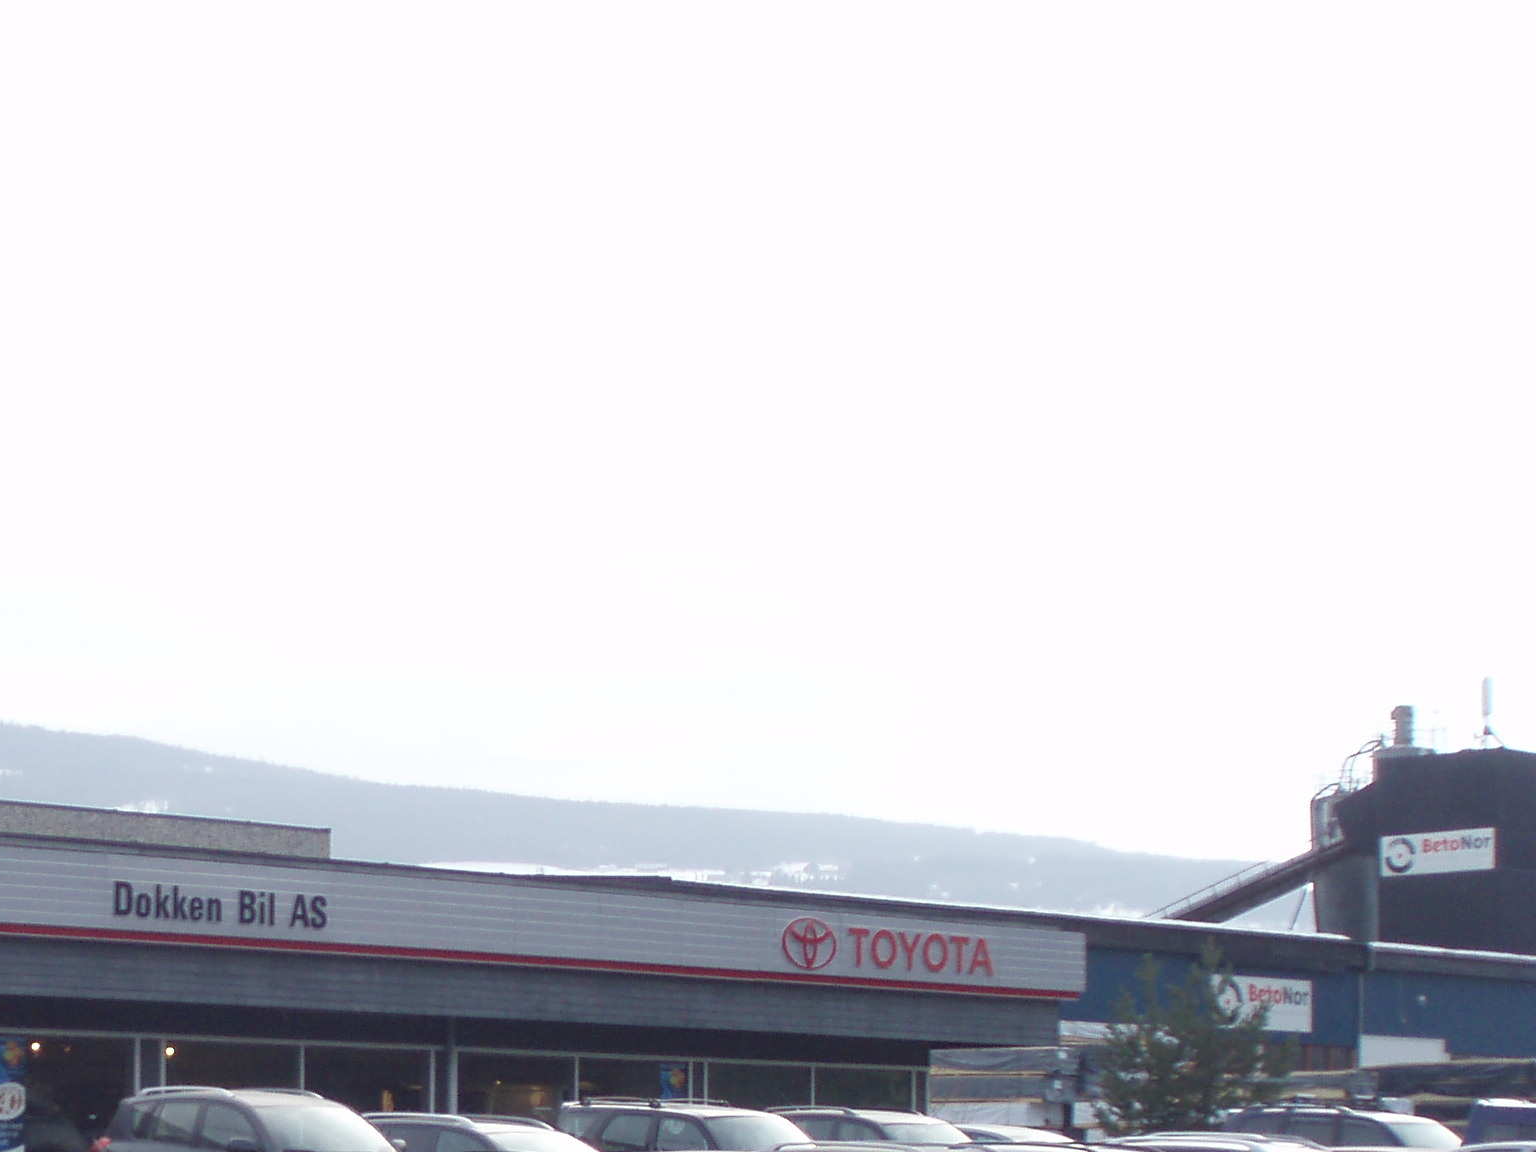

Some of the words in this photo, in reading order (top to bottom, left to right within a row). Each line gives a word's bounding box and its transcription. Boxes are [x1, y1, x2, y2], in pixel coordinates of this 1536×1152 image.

[113, 880, 223, 923] Dokken
[238, 889, 276, 927] Bil
[289, 893, 328, 929] AS
[847, 927, 994, 977] TOYOTA
